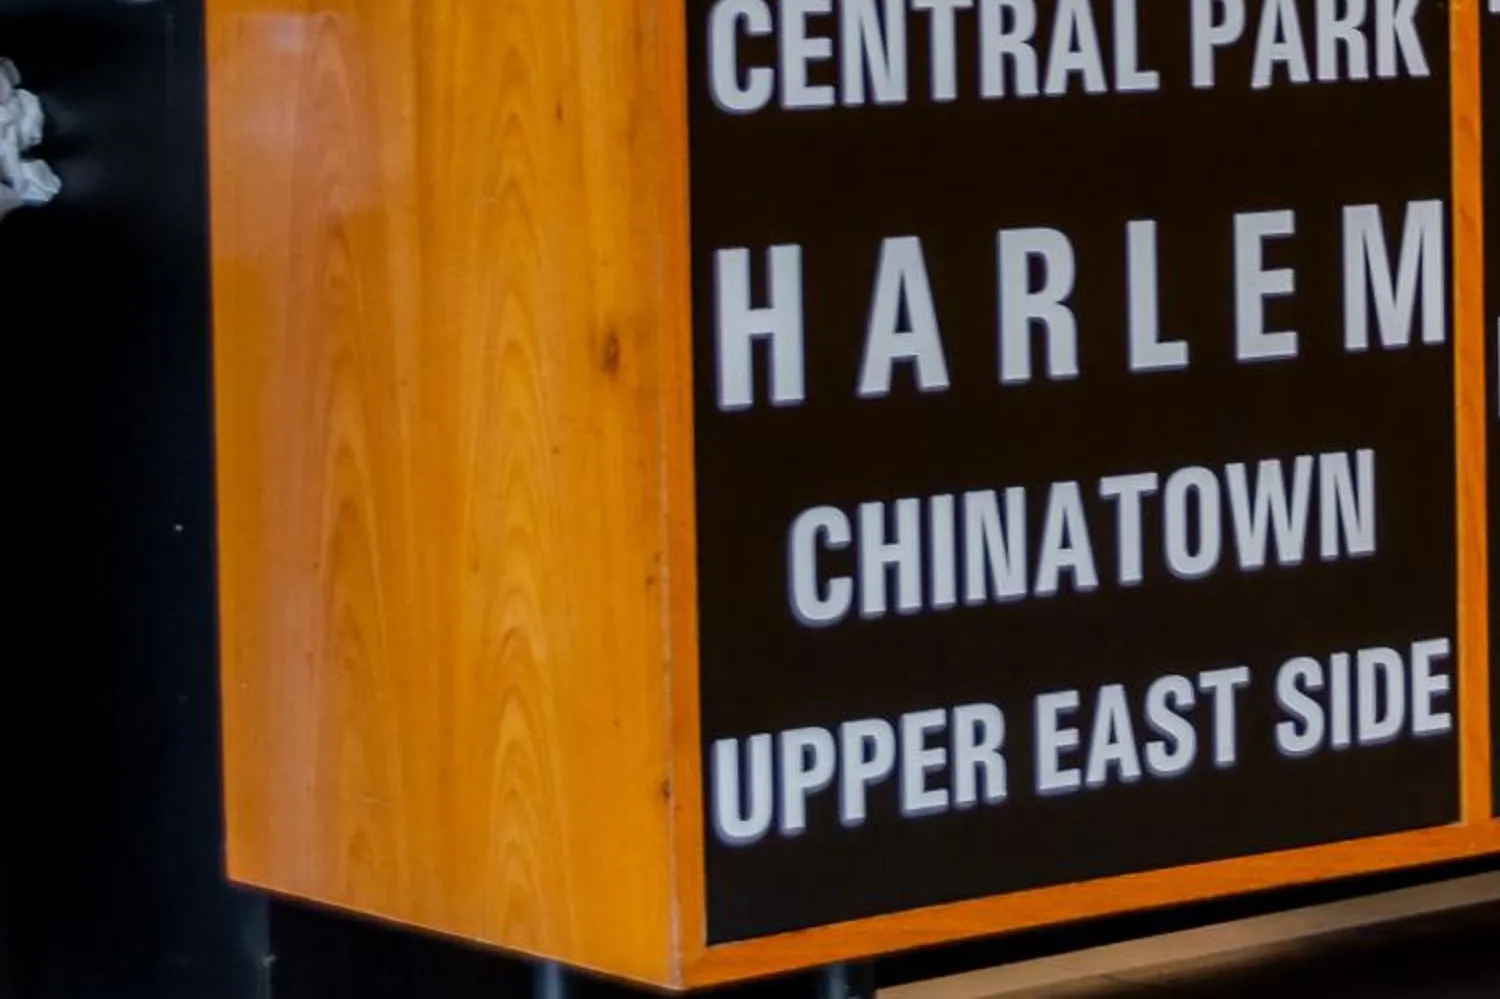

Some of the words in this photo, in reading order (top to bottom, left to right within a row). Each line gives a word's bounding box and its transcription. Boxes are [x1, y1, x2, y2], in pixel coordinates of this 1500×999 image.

[714, 198, 1447, 412] HARLEM
[788, 447, 1378, 625] CHINATOWN
[712, 701, 1009, 845] UPPER
[1034, 664, 1251, 797] EAST
[1274, 636, 1454, 757] SIDE
